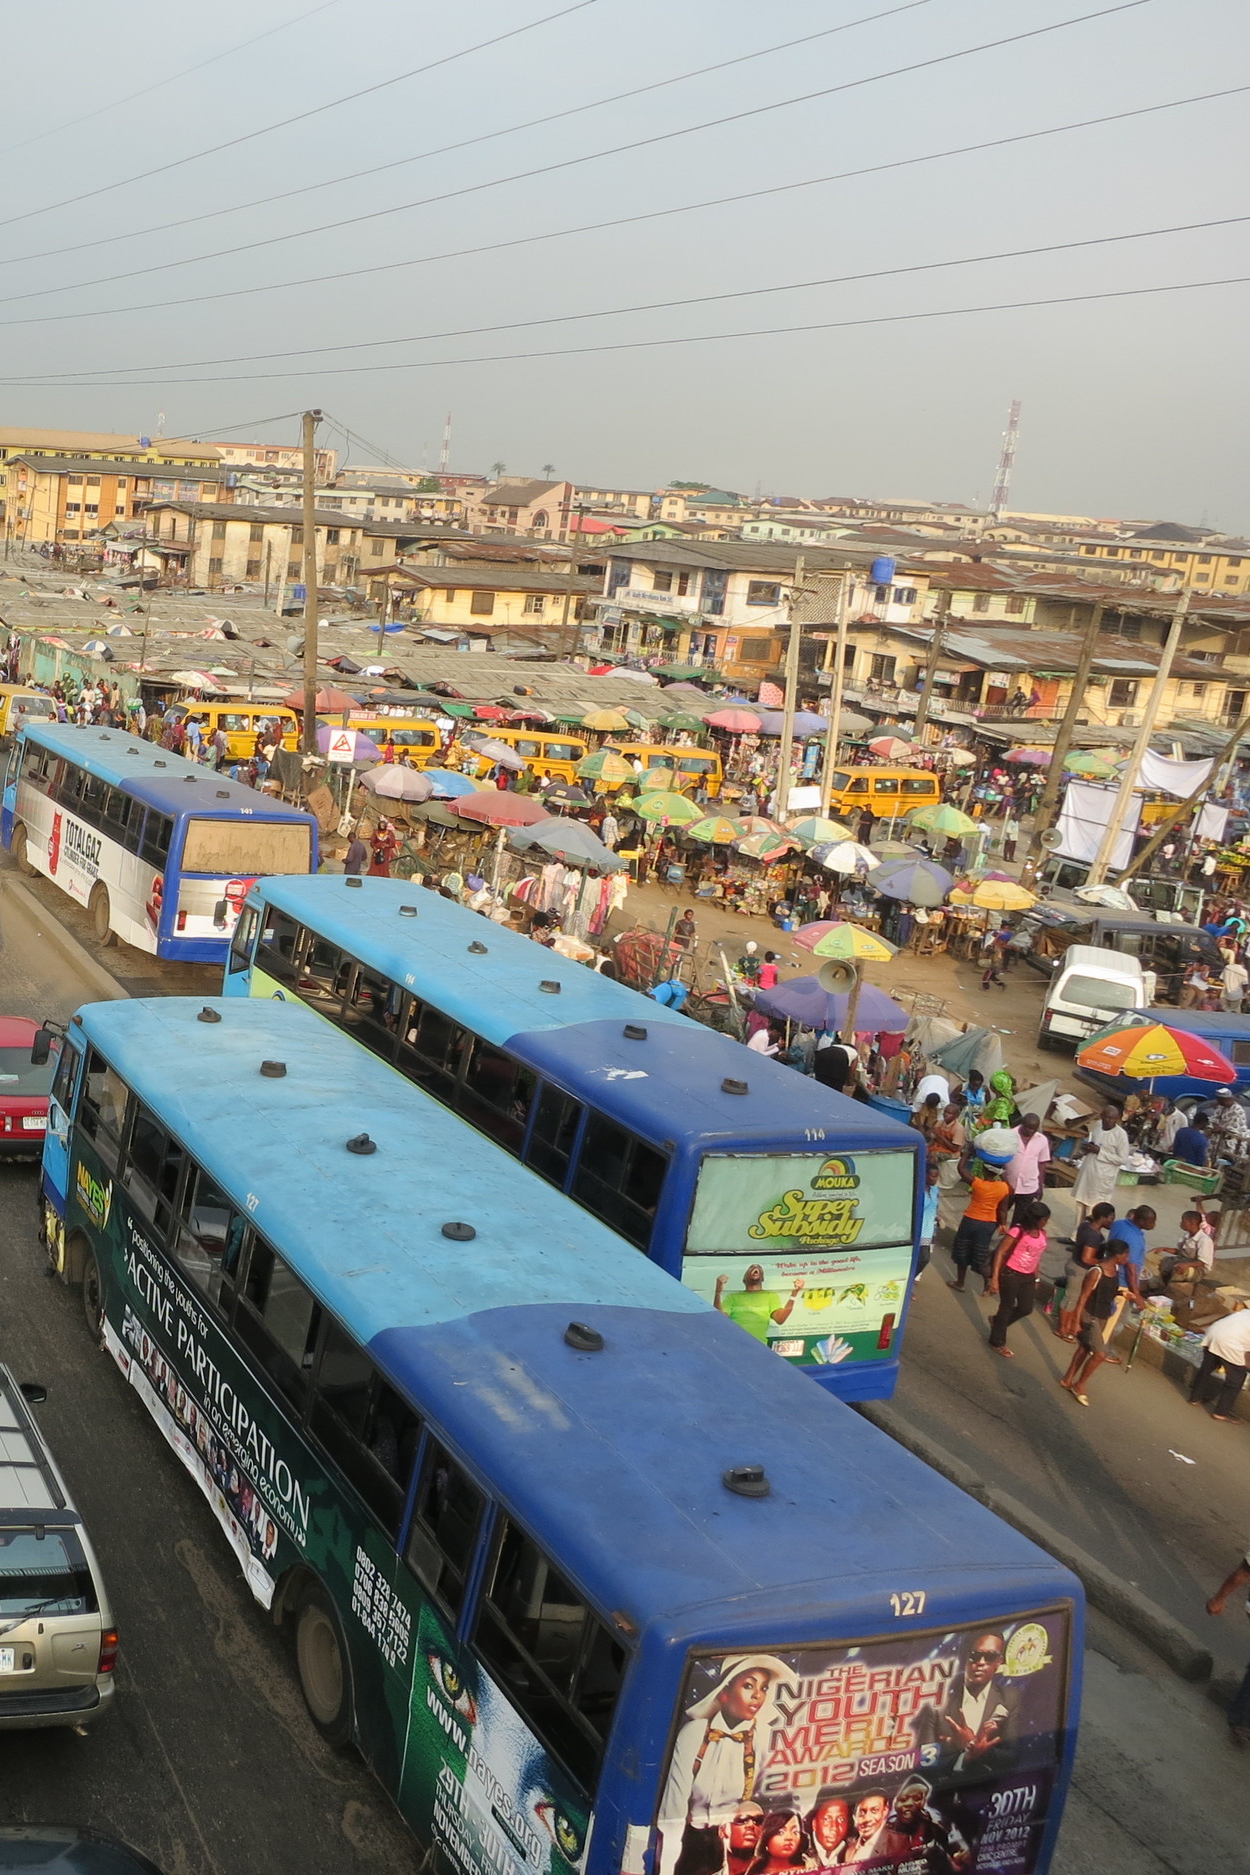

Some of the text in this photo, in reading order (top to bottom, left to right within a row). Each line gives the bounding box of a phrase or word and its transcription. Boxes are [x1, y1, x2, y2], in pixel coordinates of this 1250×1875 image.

[66, 818, 102, 867] TOTALGAZ
[804, 1128, 826, 1141] 114
[815, 1177, 855, 1188] MOUKA
[246, 1192, 260, 1213] 127
[773, 1189, 860, 1222] Super
[748, 1211, 865, 1245] Subsidy
[132, 1229, 208, 1340] positioning the youths for
[127, 1252, 310, 1531] ACTIVE PARTICIPATION
[204, 1391, 212, 1413] in
[211, 1407, 223, 1428] an
[222, 1421, 259, 1483] emerging
[355, 1562, 373, 1596] 0706
[373, 1589, 389, 1618] 838
[356, 1545, 375, 1580] 0802
[376, 1572, 391, 1601] 328
[372, 1606, 386, 1633] 357
[890, 1590, 926, 1617] 127
[775, 1658, 956, 1700] NIGERIAN
[827, 1664, 865, 1678] THE
[774, 1679, 946, 1727] YOUTH
[771, 1711, 913, 1750] MERIT
[766, 1734, 912, 1769] AWARDS
[859, 1744, 938, 1777] SEASON 3
[426, 1685, 543, 1869] www.nayes.org
[763, 1763, 856, 1793] 2012
[435, 1778, 475, 1849] THURSDAY
[438, 1755, 470, 1821] 29TH
[479, 1818, 517, 1875] 30TH
[988, 1785, 1036, 1818] 30TH
[980, 1826, 1030, 1844] NOV 2012
[986, 1812, 1031, 1832] FRIDAY
